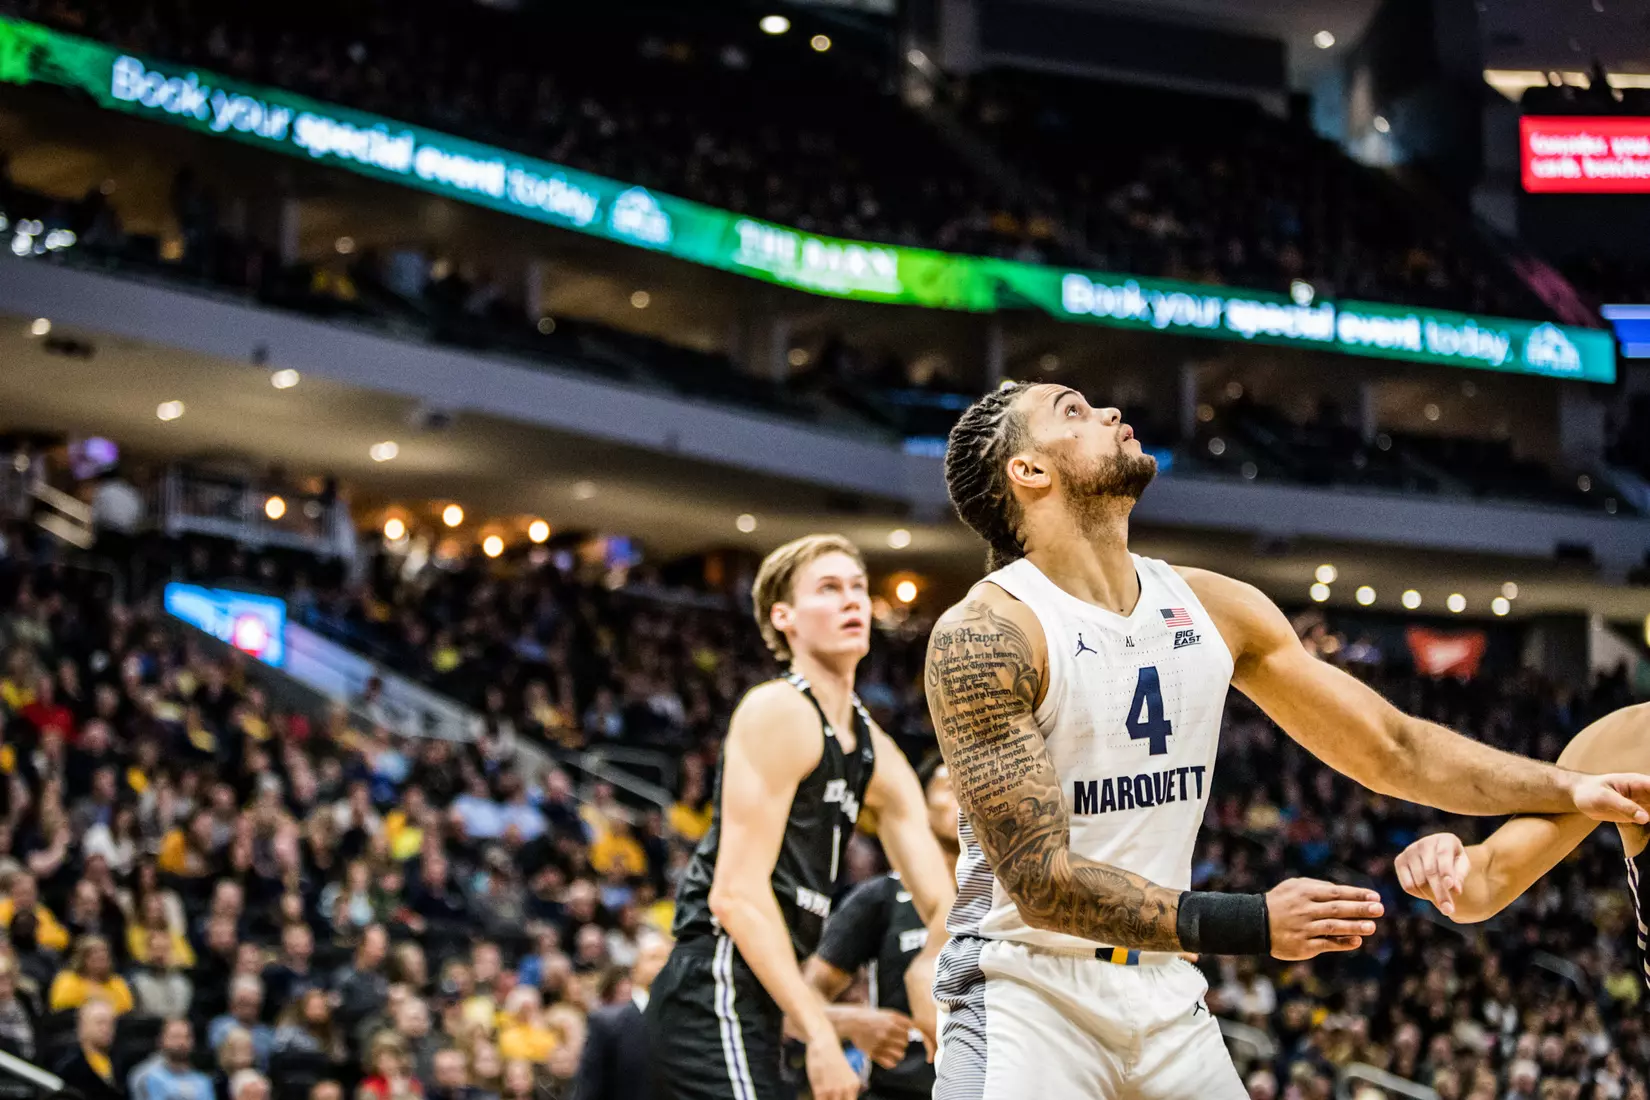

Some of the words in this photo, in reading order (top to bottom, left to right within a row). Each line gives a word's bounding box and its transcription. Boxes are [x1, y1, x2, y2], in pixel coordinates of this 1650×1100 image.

[112, 55, 210, 121] Book
[209, 88, 295, 141] your
[292, 111, 414, 174] special
[414, 143, 506, 198] event
[507, 162, 600, 227] today
[1062, 273, 1151, 321] Book
[1147, 289, 1224, 330] your
[1224, 298, 1335, 342] special
[1336, 311, 1422, 352] event
[1423, 316, 1513, 367] today
[954, 628, 1004, 647] Prayer
[1173, 635, 1202, 647] EAST
[1174, 629, 1194, 640] BIG
[1125, 665, 1173, 756] 4
[1073, 765, 1206, 815] MARQUETT
